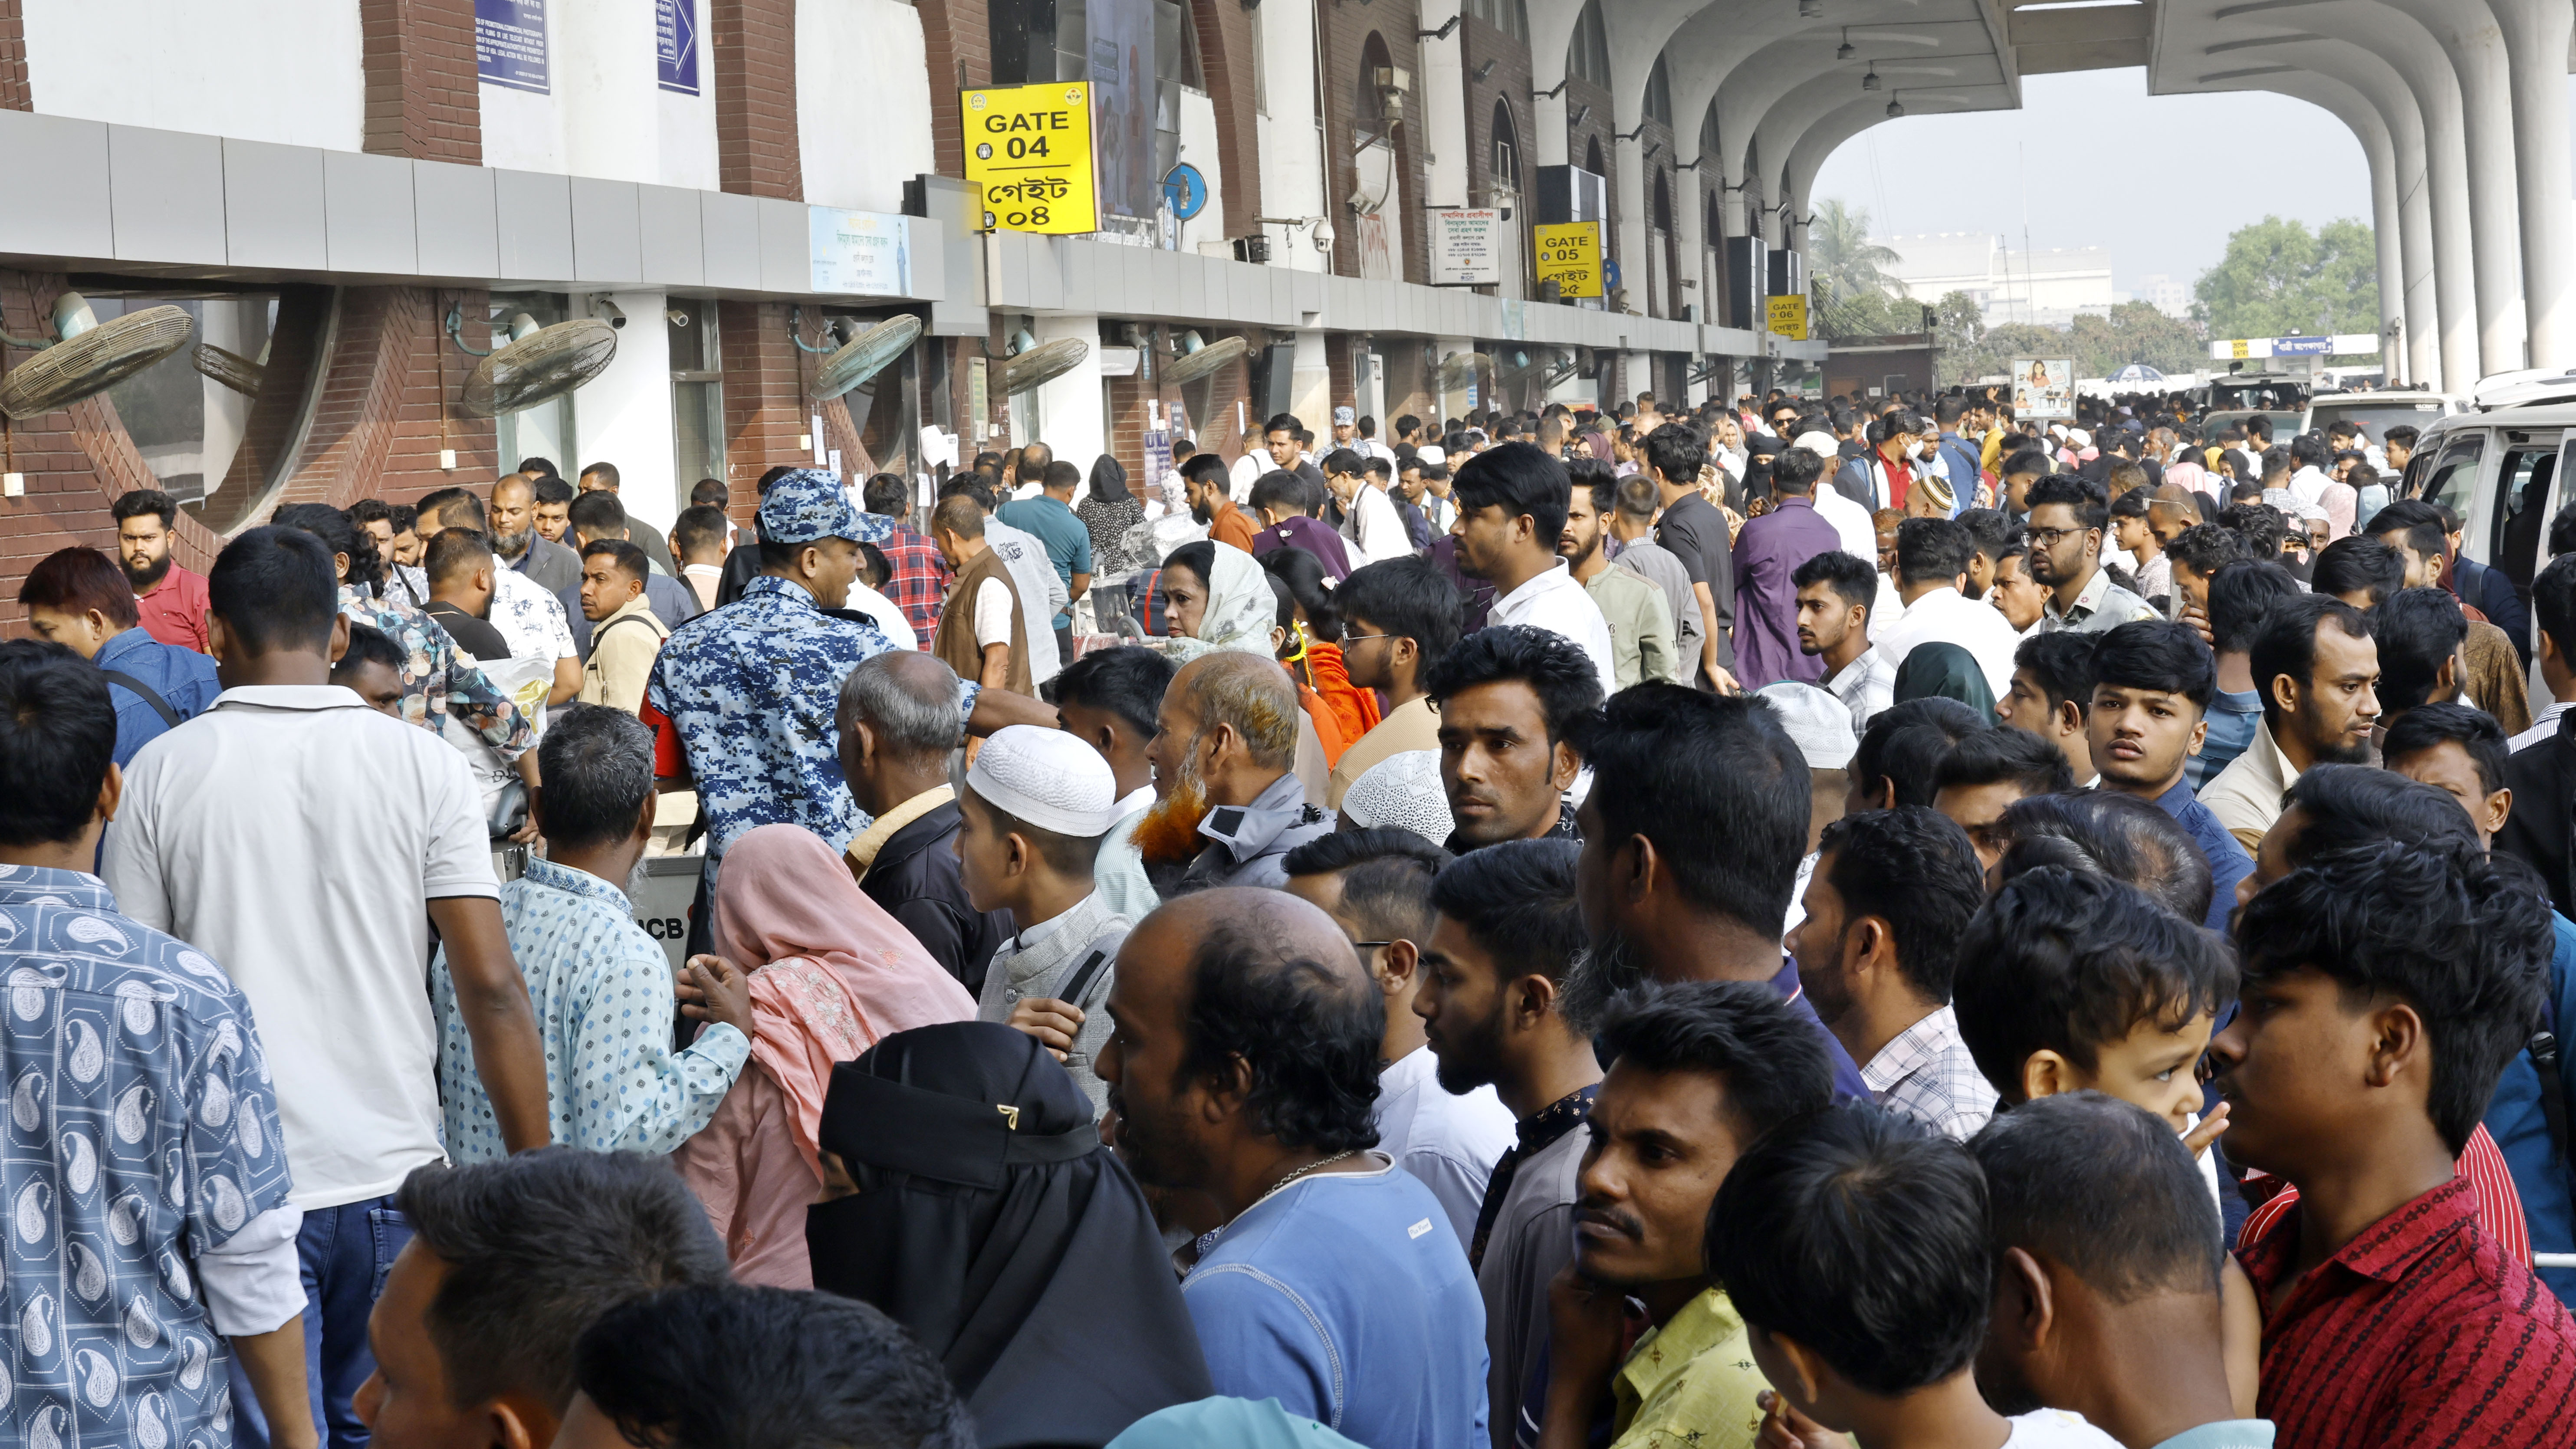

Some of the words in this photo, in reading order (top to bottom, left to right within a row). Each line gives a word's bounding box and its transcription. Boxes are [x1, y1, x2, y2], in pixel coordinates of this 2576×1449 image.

[985, 111, 1069, 133] GATE
[1007, 136, 1050, 159] 04
[988, 176, 1072, 204] গেইট
[1007, 206, 1050, 225] ০৪
[1441, 210, 1464, 219] সম্মানিত
[1467, 210, 1493, 219] প্রবাসীগণ
[1545, 236, 1588, 247] GATE
[1557, 249, 1579, 260] 05
[1543, 269, 1590, 283] গেইট
[1774, 323, 1799, 332] গেইট
[2279, 341, 2293, 351] যাত্রী
